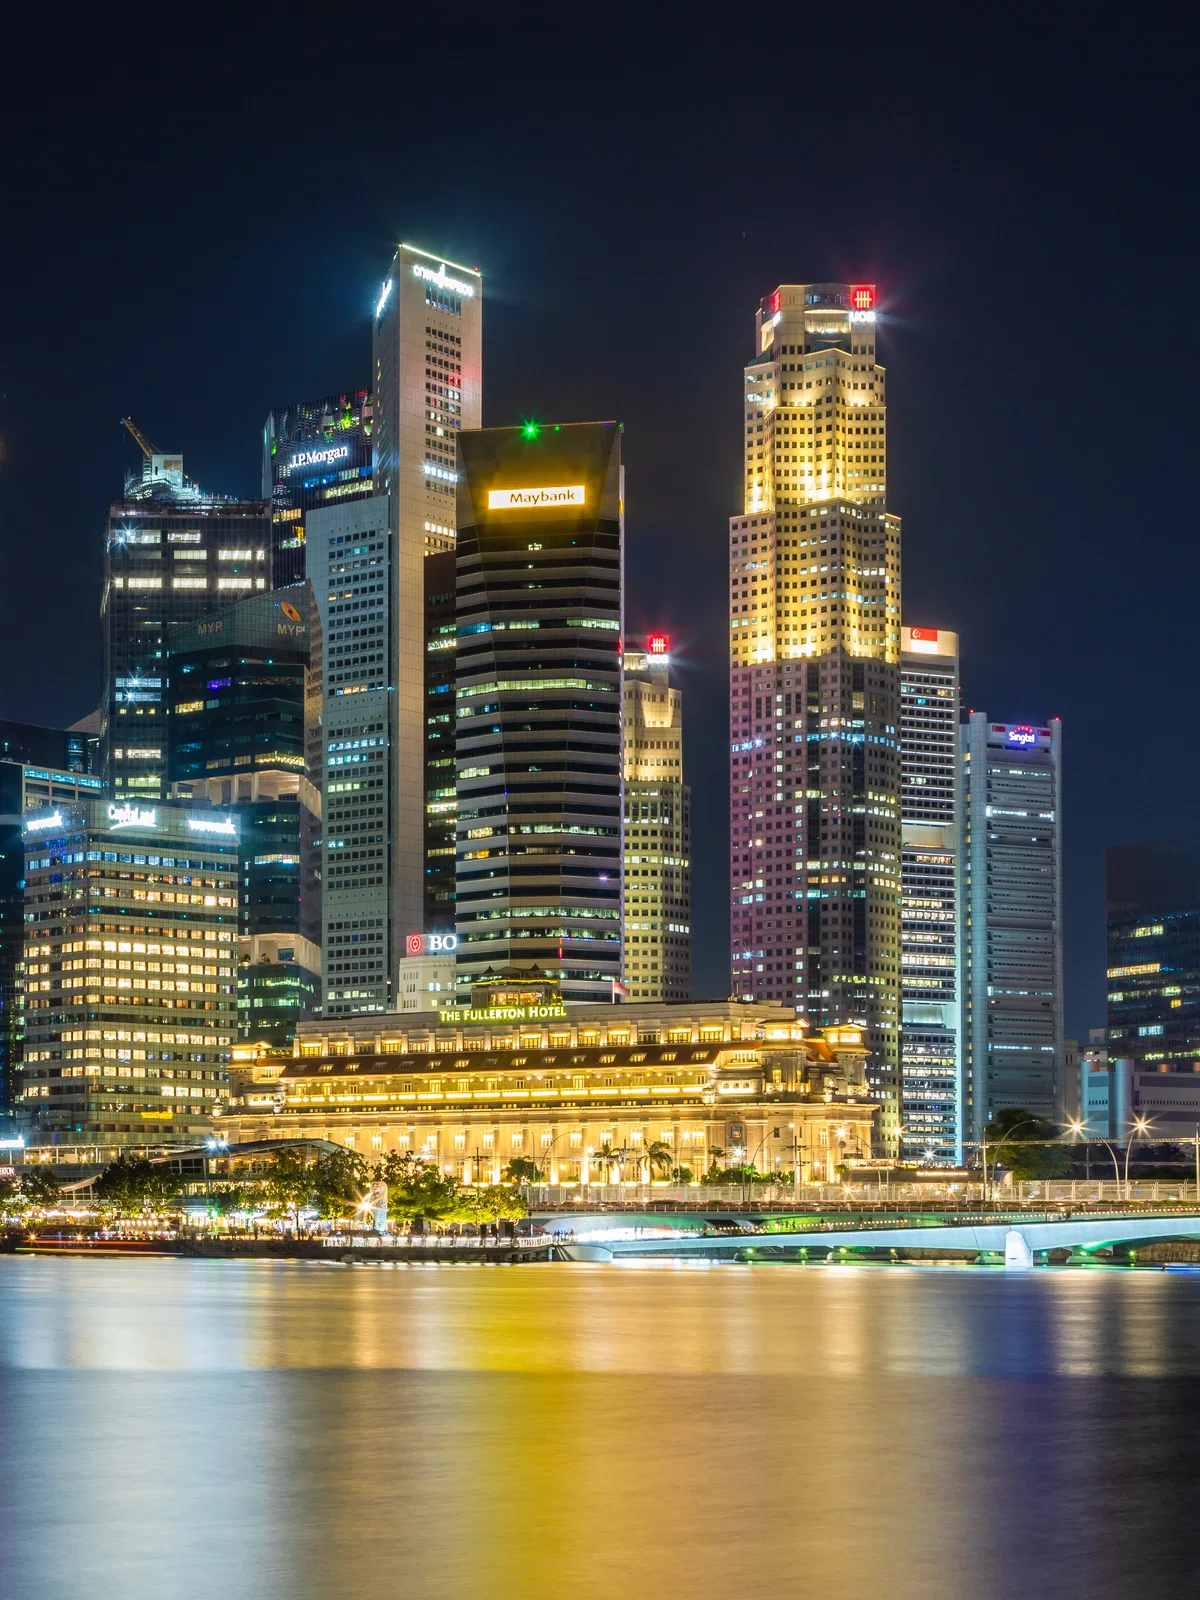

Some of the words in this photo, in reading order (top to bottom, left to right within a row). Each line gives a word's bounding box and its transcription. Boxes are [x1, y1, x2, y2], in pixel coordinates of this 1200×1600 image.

[289, 446, 348, 468] J.P.Morgan
[509, 490, 575, 505] Maybank
[197, 621, 223, 635] MYP
[277, 624, 303, 637] MYP
[1009, 731, 1035, 744] Singtel
[440, 1010, 461, 1021] THE
[463, 1008, 526, 1021] FULLERTON
[529, 1006, 567, 1018] HOTEL
